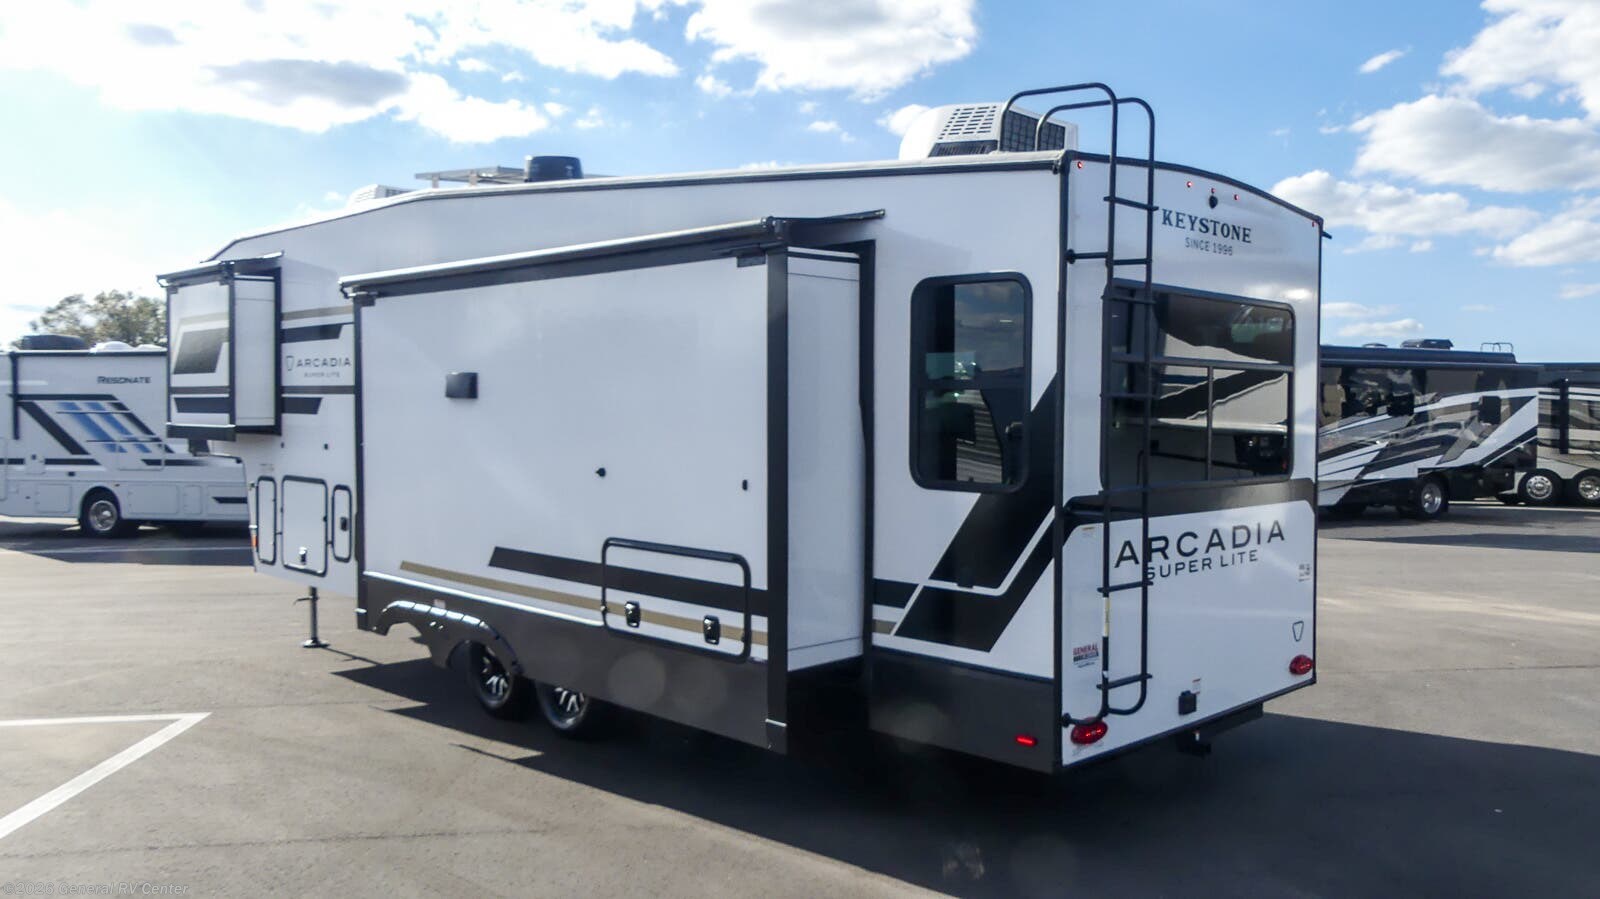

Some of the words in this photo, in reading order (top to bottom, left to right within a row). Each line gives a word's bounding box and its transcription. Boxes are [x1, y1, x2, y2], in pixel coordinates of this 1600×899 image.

[1161, 208, 1252, 243] KEYSTONE
[1185, 237, 1210, 252] SINCE
[1212, 242, 1233, 256] 1996
[296, 357, 352, 368] ARCADIA
[97, 376, 151, 384] RESONATE
[1114, 520, 1285, 569] ARCADIA
[1146, 557, 1213, 580] SUPER
[1219, 549, 1259, 568] LITE
